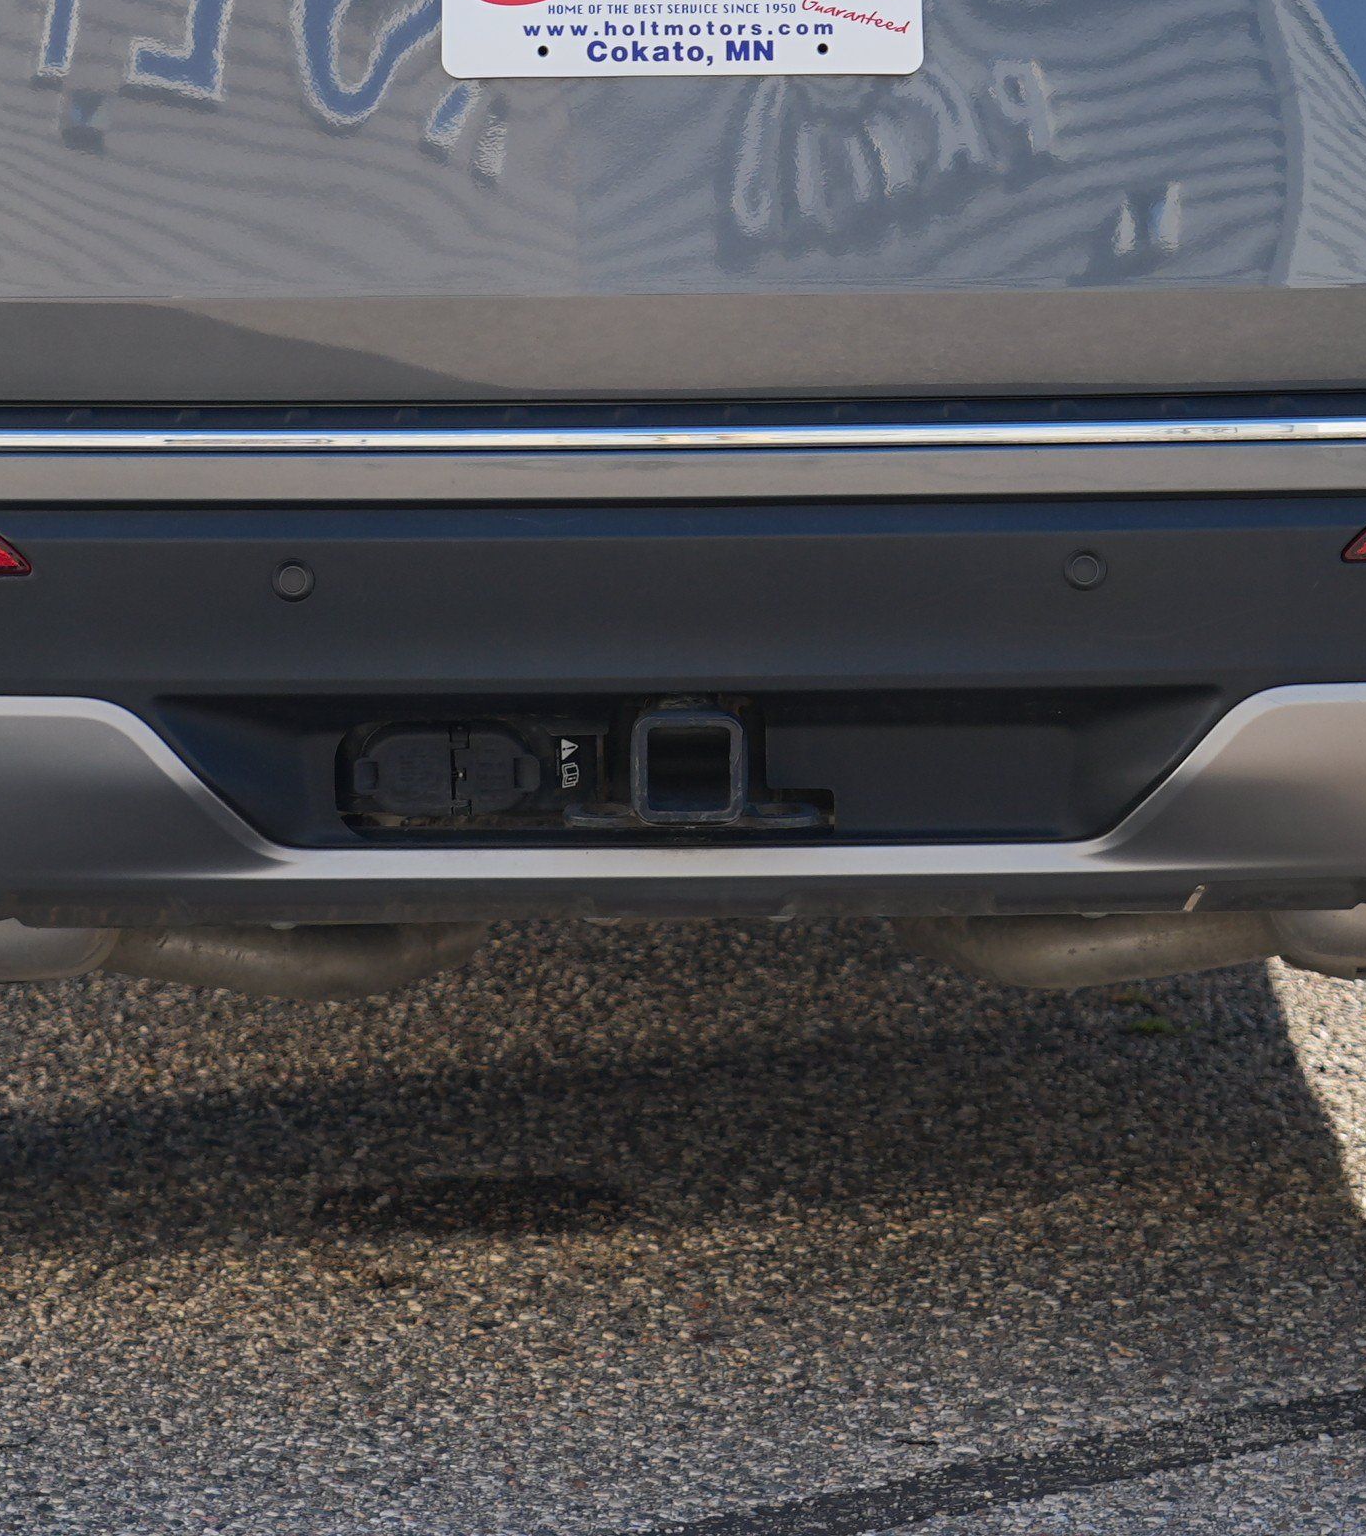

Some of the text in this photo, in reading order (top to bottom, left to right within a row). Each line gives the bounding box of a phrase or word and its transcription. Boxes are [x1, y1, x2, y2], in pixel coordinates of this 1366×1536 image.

[547, 3, 797, 15] HOME OF THE BEST SERVICE SINCE 1950
[522, 20, 834, 37] www.holtmotors.com
[586, 40, 775, 67] Cokato, MN
